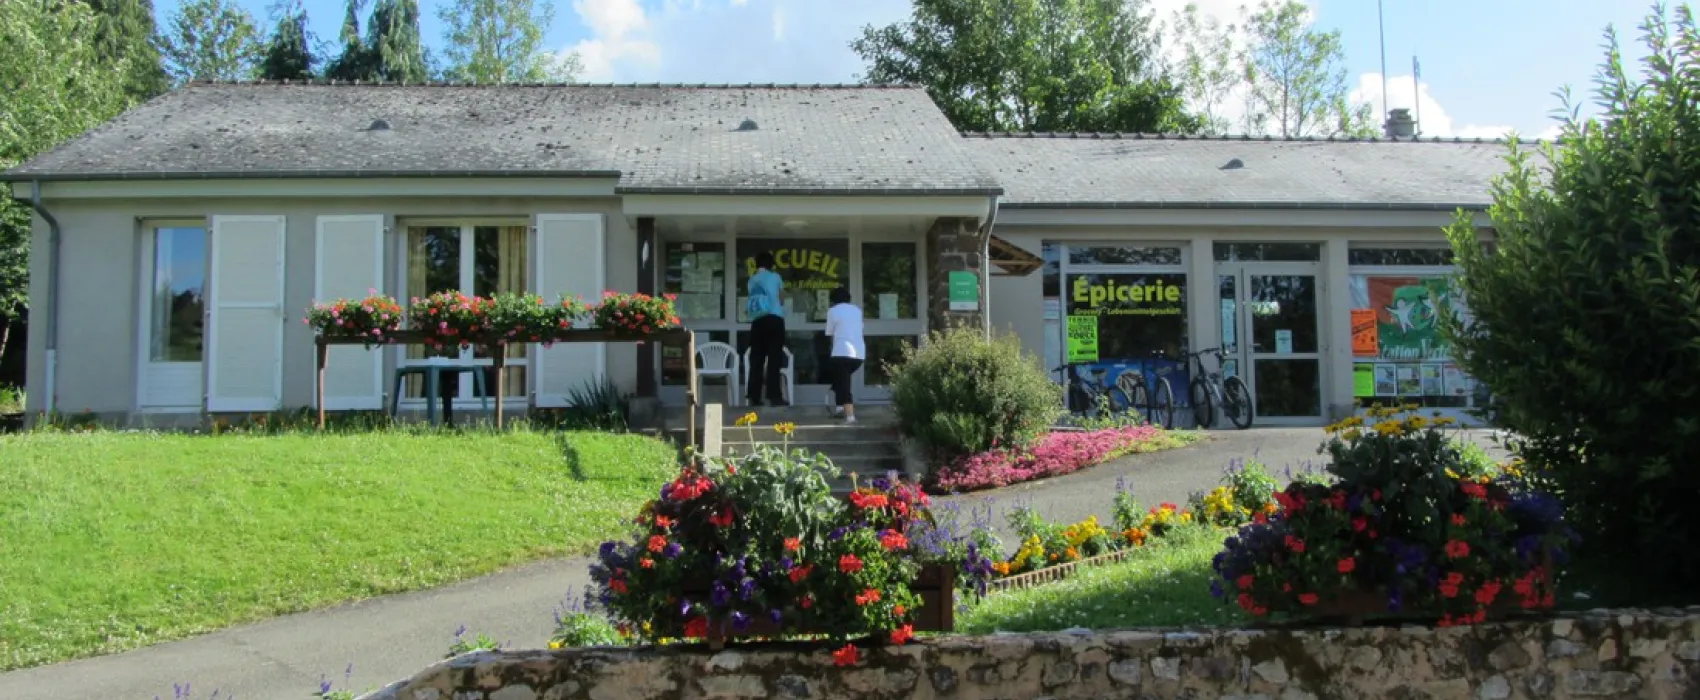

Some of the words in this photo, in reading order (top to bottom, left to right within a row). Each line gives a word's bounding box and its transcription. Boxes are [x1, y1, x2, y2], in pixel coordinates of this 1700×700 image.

[744, 248, 840, 278] ACUEIL
[1073, 275, 1180, 307] Épicerie
[1379, 342, 1420, 360] tation
